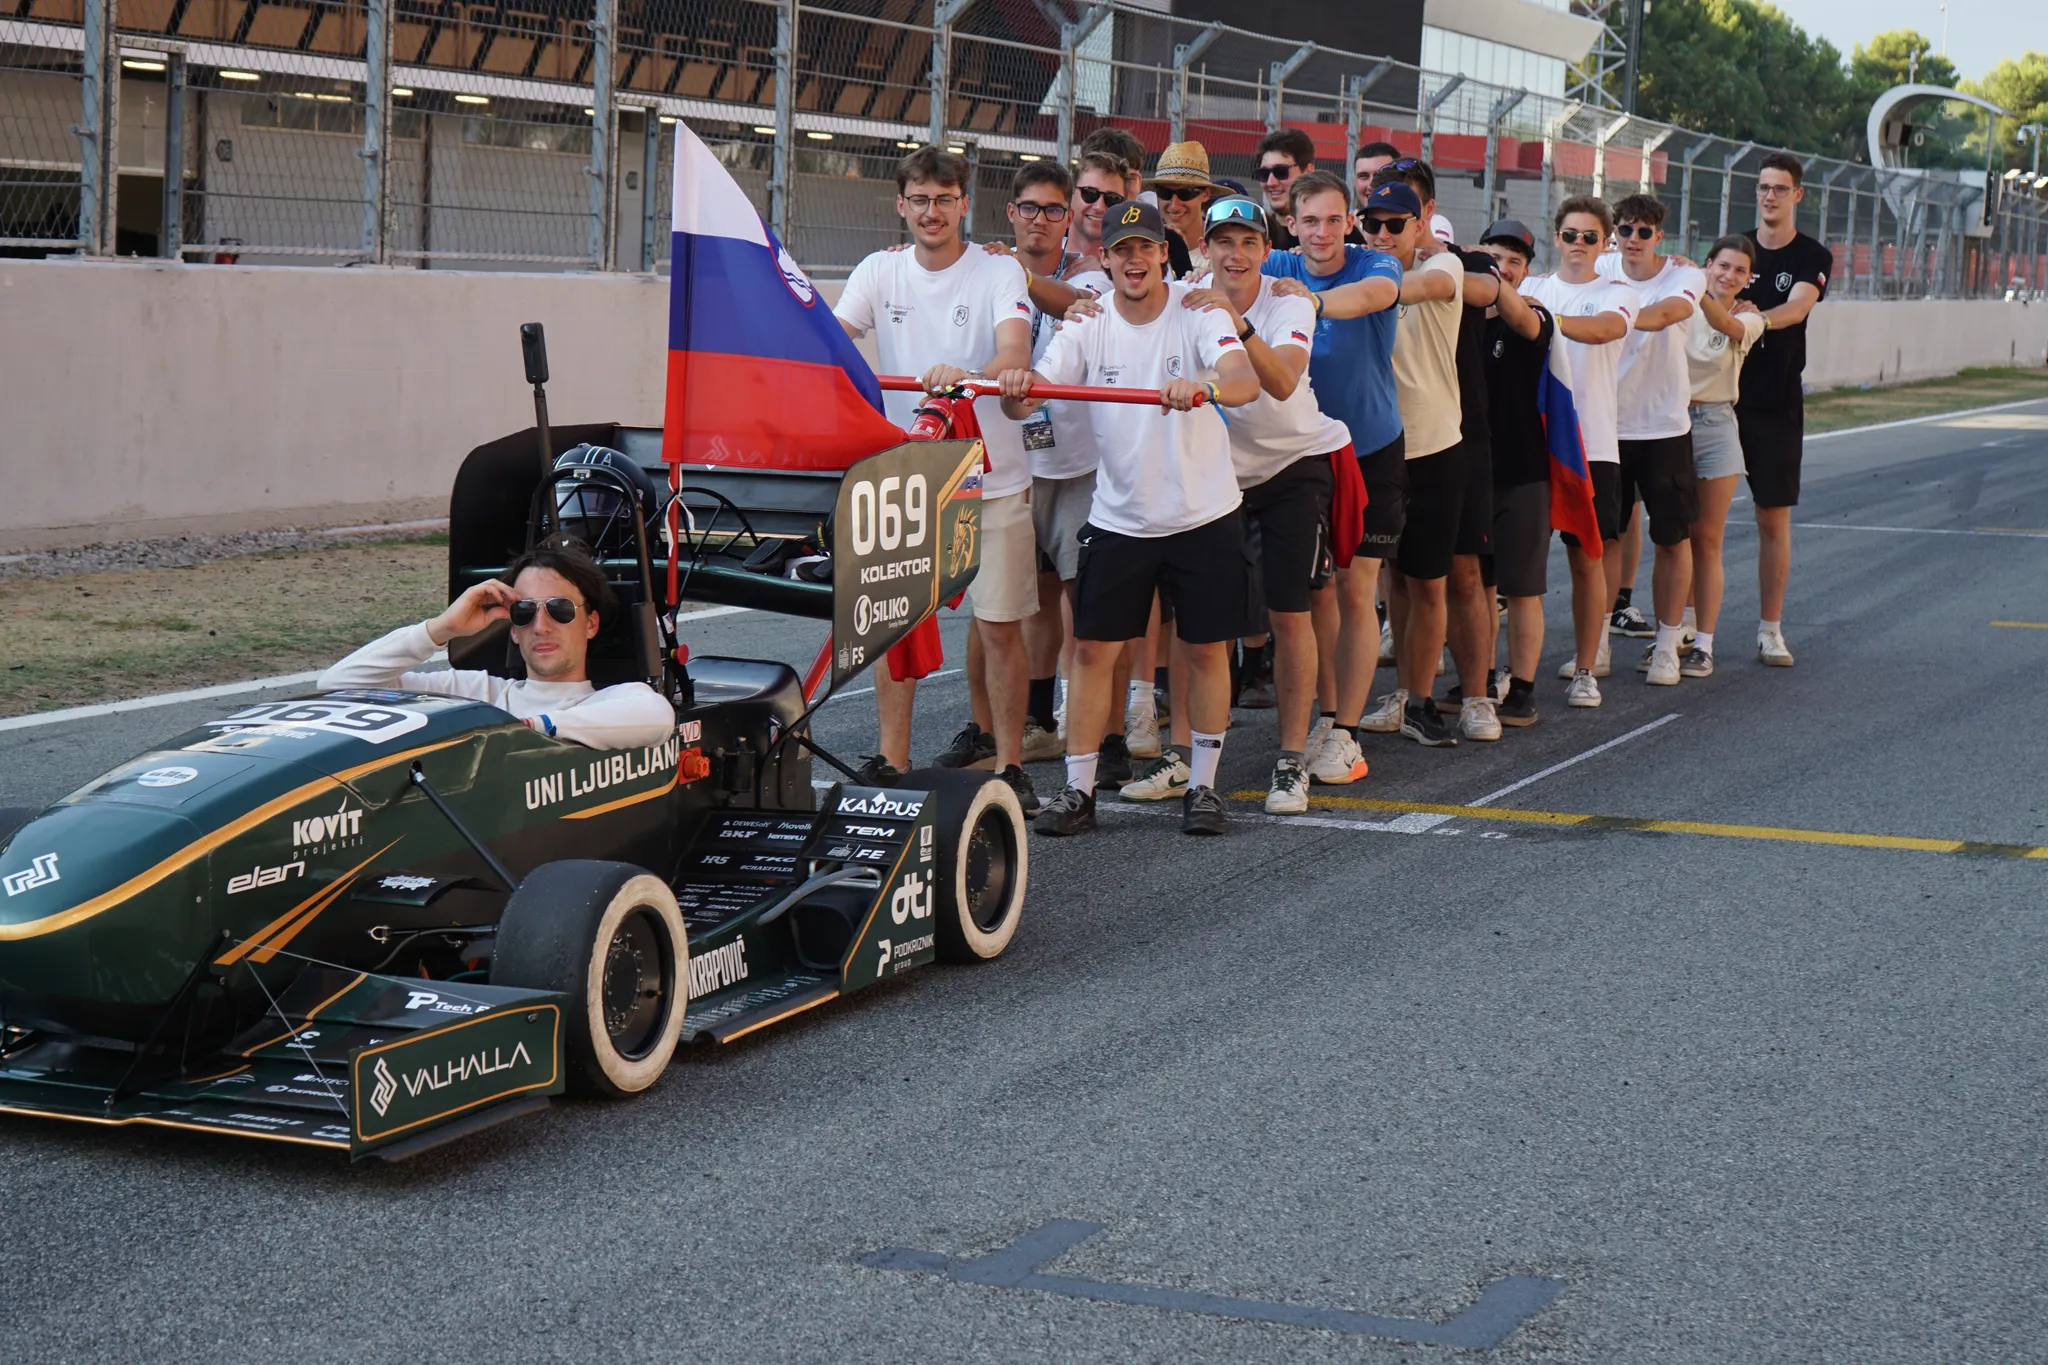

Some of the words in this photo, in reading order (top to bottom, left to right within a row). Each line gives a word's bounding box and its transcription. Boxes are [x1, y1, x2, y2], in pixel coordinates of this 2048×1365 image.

[1121, 206, 1141, 225] B
[851, 473, 928, 556] 069
[861, 557, 931, 584] KOLEKTOR
[872, 596, 909, 624] SILIKO
[852, 646, 865, 666] FS
[525, 772, 564, 810] UNI
[570, 736, 680, 797] LJUBLJANA
[838, 791, 923, 817] KAMPUS
[719, 830, 758, 838] SKF
[845, 825, 896, 838] TEM
[293, 836, 364, 861] projekti
[856, 849, 886, 860] FE
[227, 861, 306, 895] elan
[891, 868, 933, 925] dti
[436, 1001, 472, 1013] Tech
[402, 1041, 532, 1098] VALHALLA
